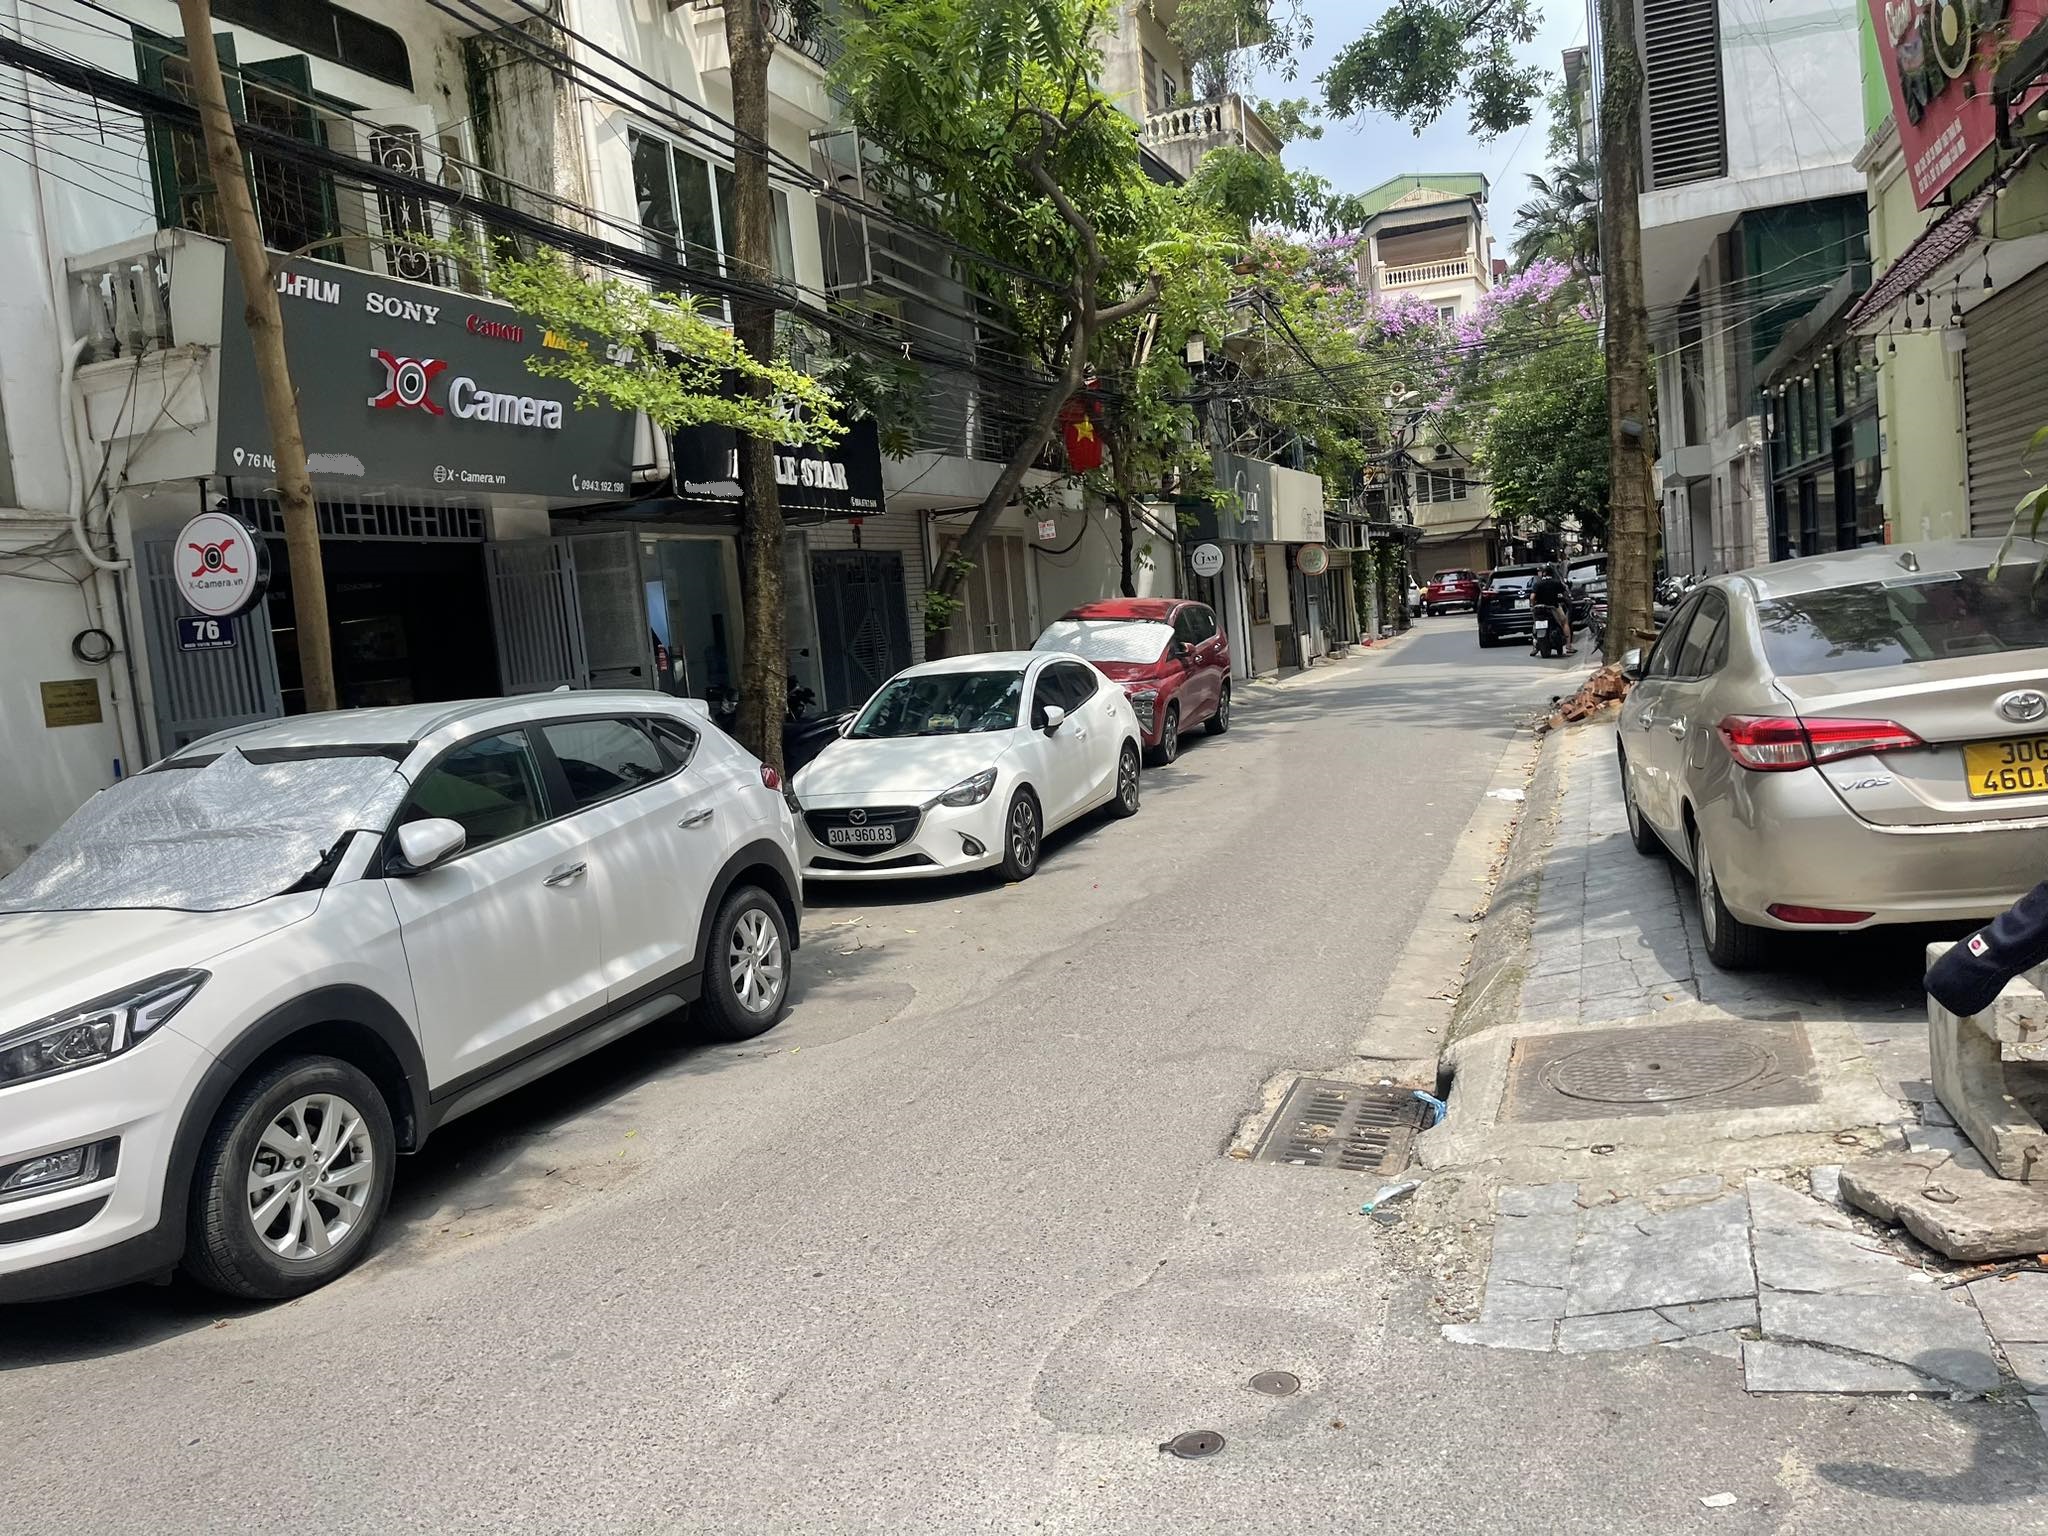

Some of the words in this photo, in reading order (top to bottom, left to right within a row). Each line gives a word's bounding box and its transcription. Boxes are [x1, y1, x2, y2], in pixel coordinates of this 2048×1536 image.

[275, 271, 341, 304] JIFILM
[366, 292, 440, 325] SONY
[466, 313, 524, 344] Canon
[449, 376, 563, 430] Camera
[247, 453, 261, 468] 76
[460, 470, 506, 484] Camera.vn
[800, 457, 849, 490] STAR
[188, 578, 244, 590] X-Camera.vn
[192, 620, 220, 641] 76
[1840, 776, 1891, 791] VIOS
[829, 828, 893, 843] 30A-960.83
